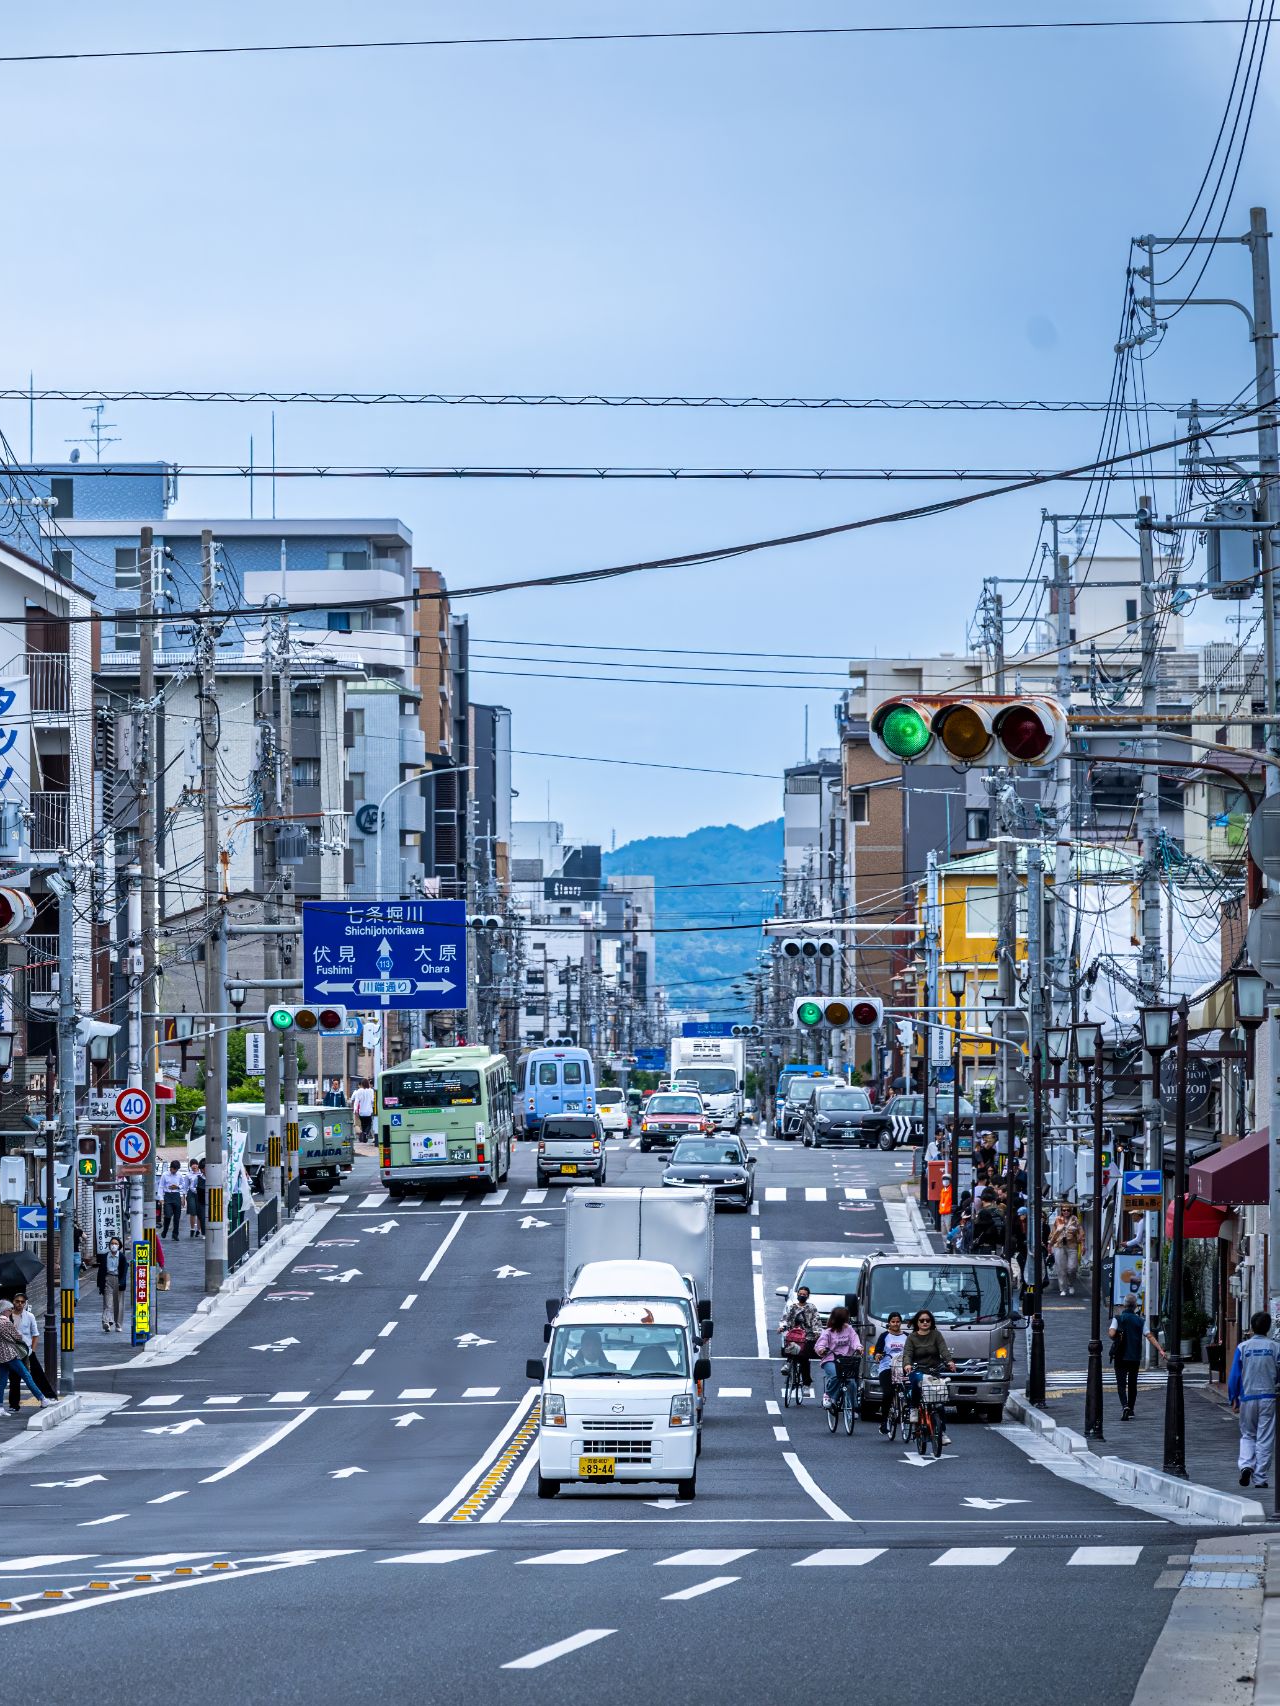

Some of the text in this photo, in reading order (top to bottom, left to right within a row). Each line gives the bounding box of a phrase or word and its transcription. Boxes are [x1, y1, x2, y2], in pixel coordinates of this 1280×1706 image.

[346, 906, 423, 923] 七条堀川
[345, 926, 425, 937] Shichijohorikawa
[313, 945, 356, 963] 伏見
[414, 944, 457, 962] 大原
[379, 960, 390, 968] 113
[421, 964, 450, 974] Ohara
[316, 966, 353, 975] Fushimi
[362, 982, 408, 993] 川端通り
[1160, 1083, 1207, 1094] Amzon
[123, 1098, 144, 1115] 40
[306, 1148, 342, 1158] KANDA
[586, 1464, 613, 1474] 89-44
